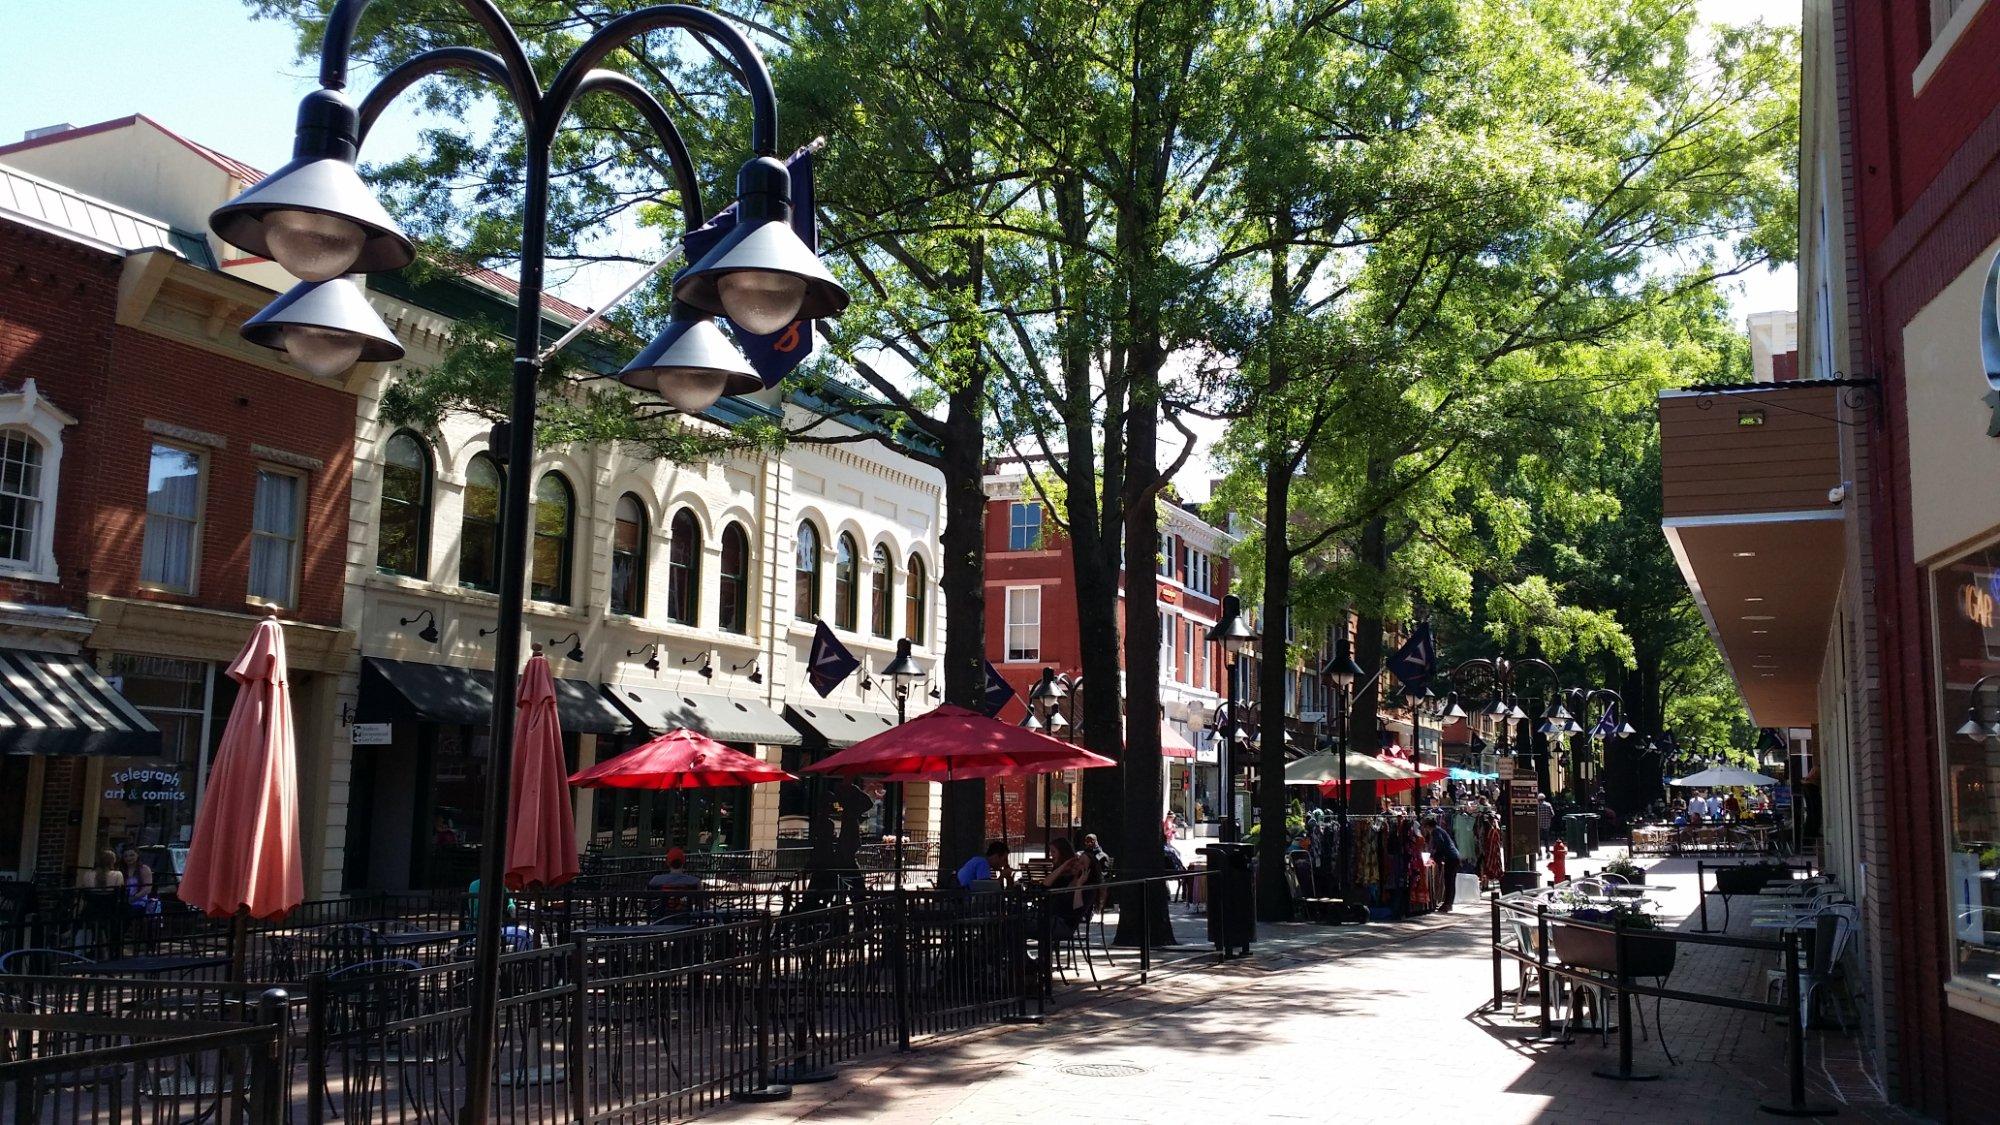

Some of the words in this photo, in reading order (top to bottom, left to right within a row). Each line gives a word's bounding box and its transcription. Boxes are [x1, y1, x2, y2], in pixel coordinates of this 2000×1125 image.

[111, 767, 181, 787] Telegraph
[104, 788, 126, 799] art
[128, 787, 138, 800] &
[142, 788, 185, 800] comics
